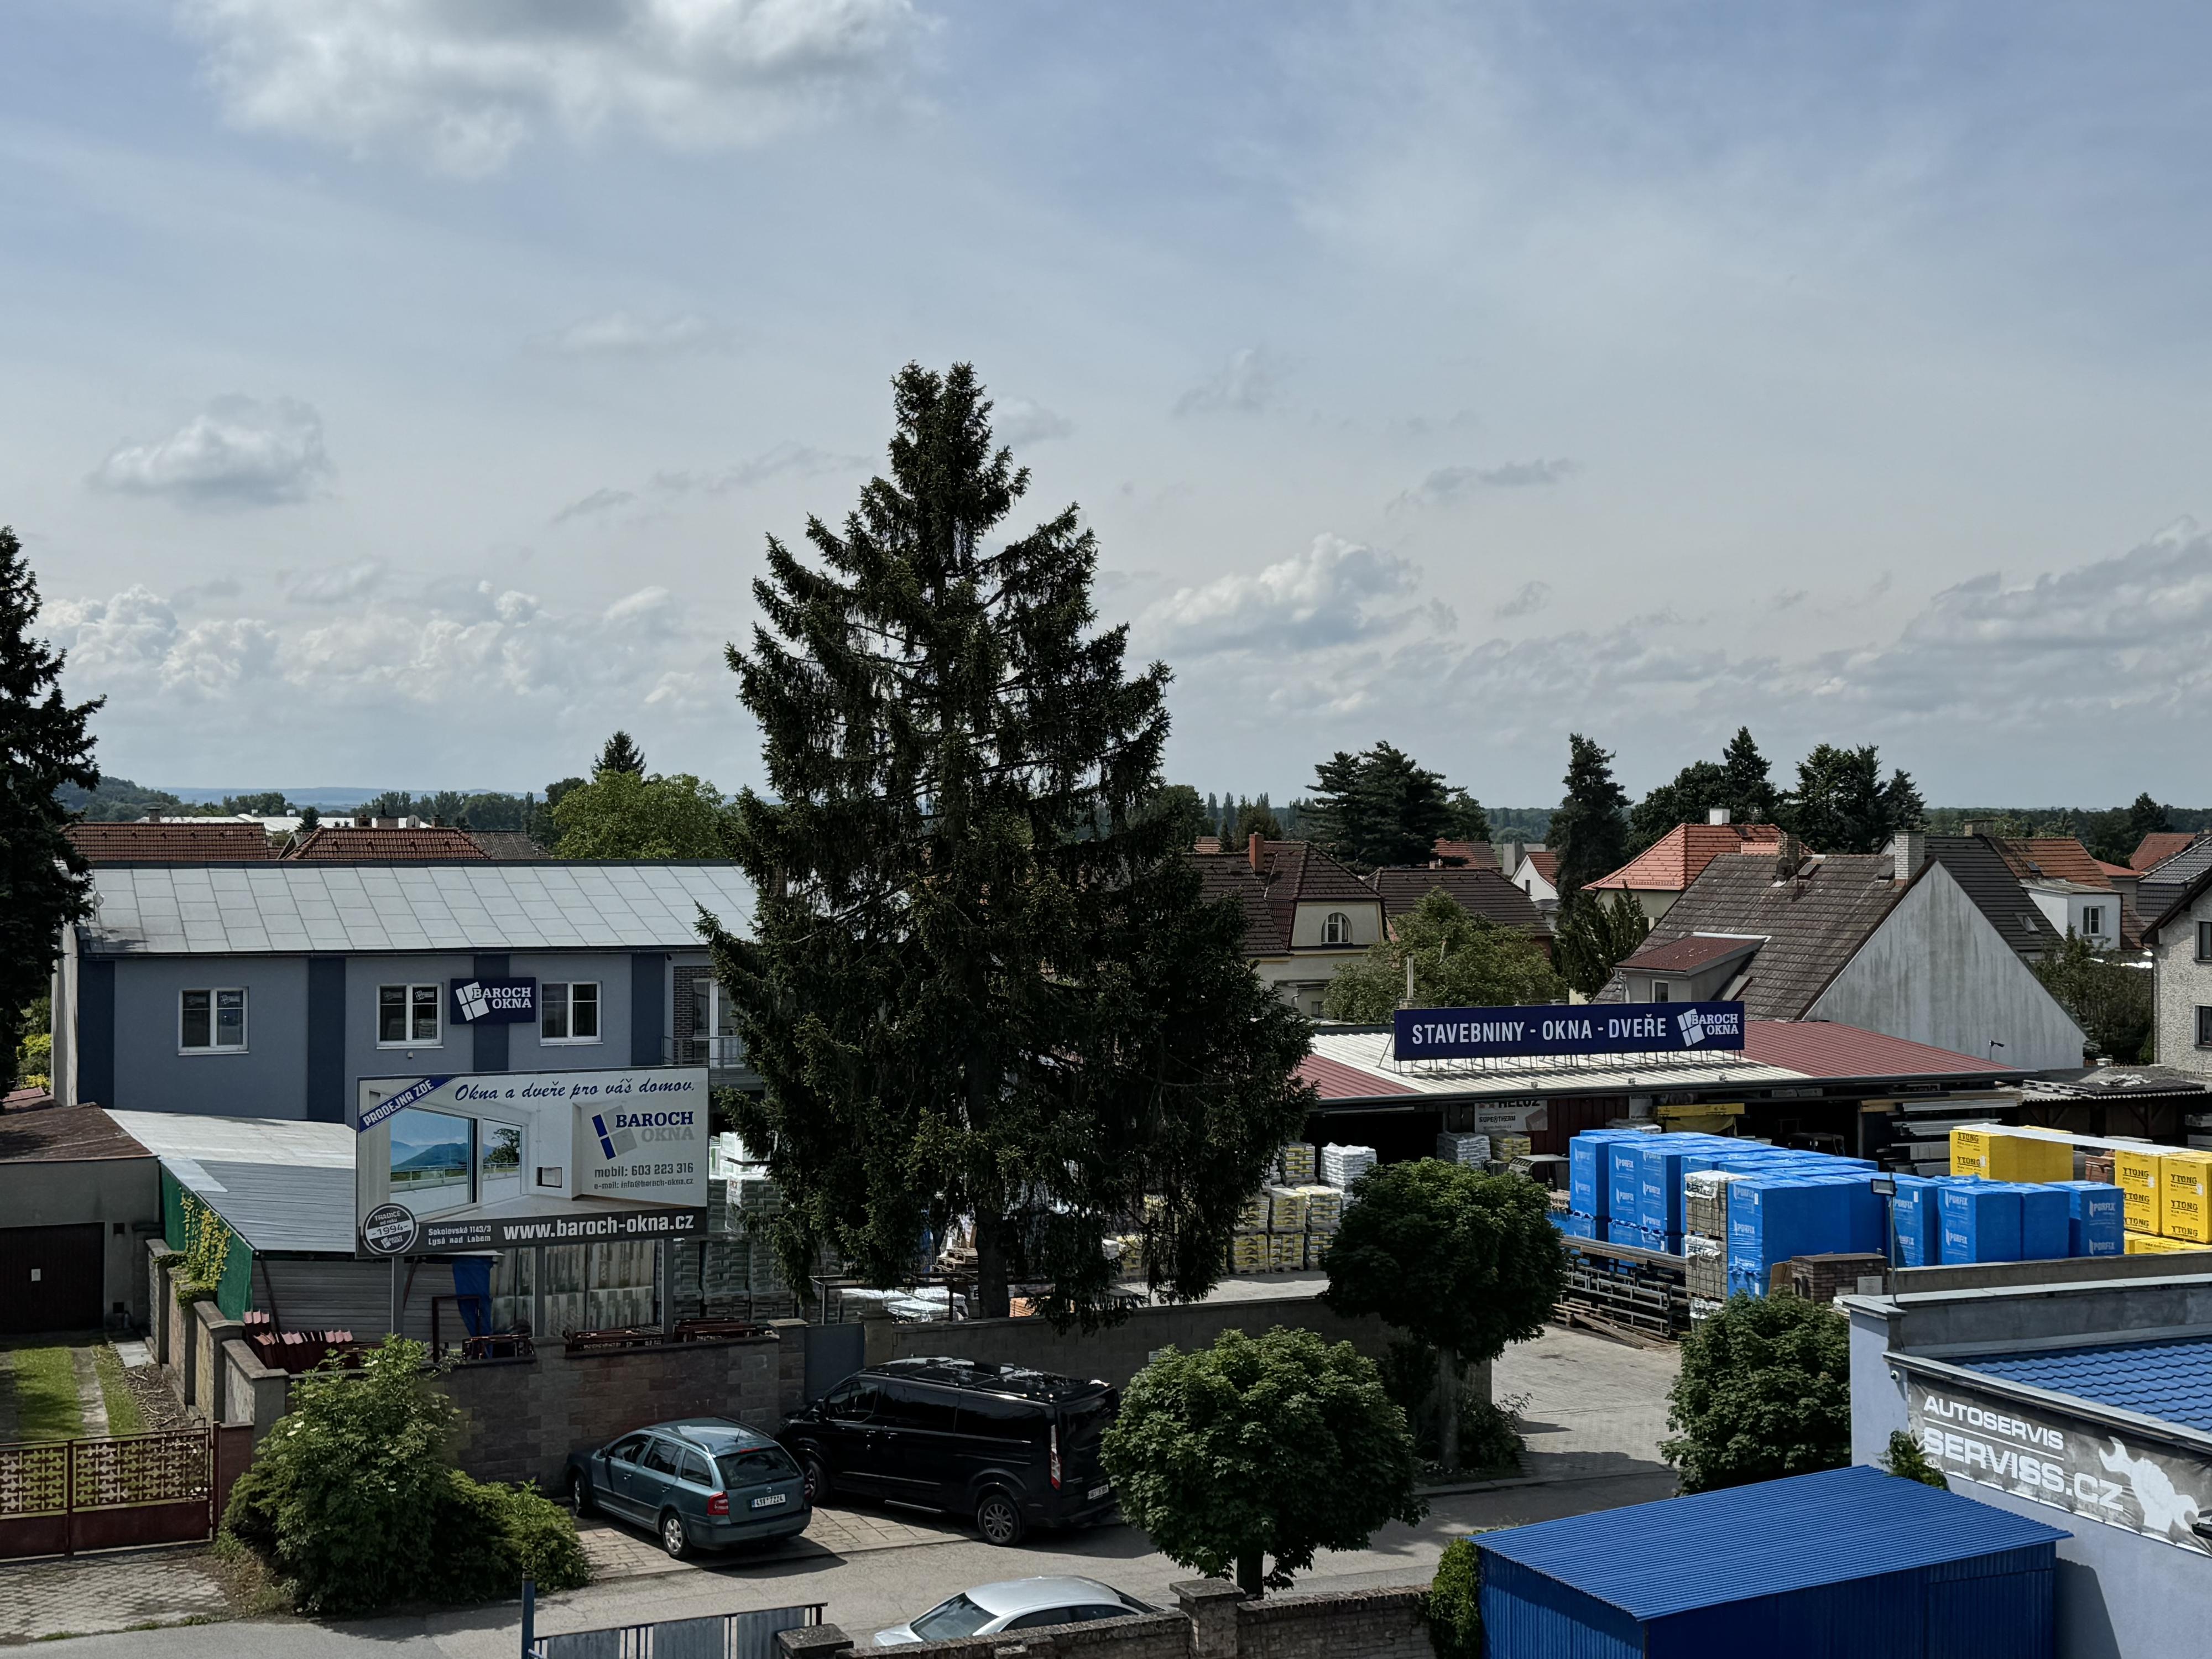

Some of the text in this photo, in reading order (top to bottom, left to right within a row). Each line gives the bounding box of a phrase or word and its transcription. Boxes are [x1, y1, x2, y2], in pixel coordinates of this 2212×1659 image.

[473, 987, 531, 999] BAROCH
[492, 998, 532, 1009] OKNA
[1691, 1014, 1738, 1025] BAROCH
[1412, 1021, 1525, 1044] STAVEBNINY
[1542, 1019, 1592, 1040] OKNA
[1609, 1013, 1666, 1038] DVEŘE
[1707, 1024, 1739, 1035] OKNA
[455, 1077, 695, 1101] Okna a dveře pro váš domov.
[363, 1079, 434, 1126] PRODEJNA ZDE
[615, 1111, 694, 1128] BAROCH
[641, 1126, 695, 1142] OKNA
[594, 1162, 694, 1178] mobil: 603 223 316
[2123, 1167, 2150, 1177] YTONG
[2171, 1173, 2198, 1185] YTONG
[2171, 1199, 2198, 1211] YTONG
[428, 1225, 492, 1236] Sokolovská 1143/3
[503, 1214, 694, 1240] www.baroch-okna.cz
[2171, 1225, 2198, 1237] YTONG
[428, 1237, 446, 1246] Lysá
[467, 1235, 491, 1243] Labem
[1923, 1395, 2065, 1451] AUTOSERVIS
[1923, 1427, 2124, 1512] SERVISS.CZ
